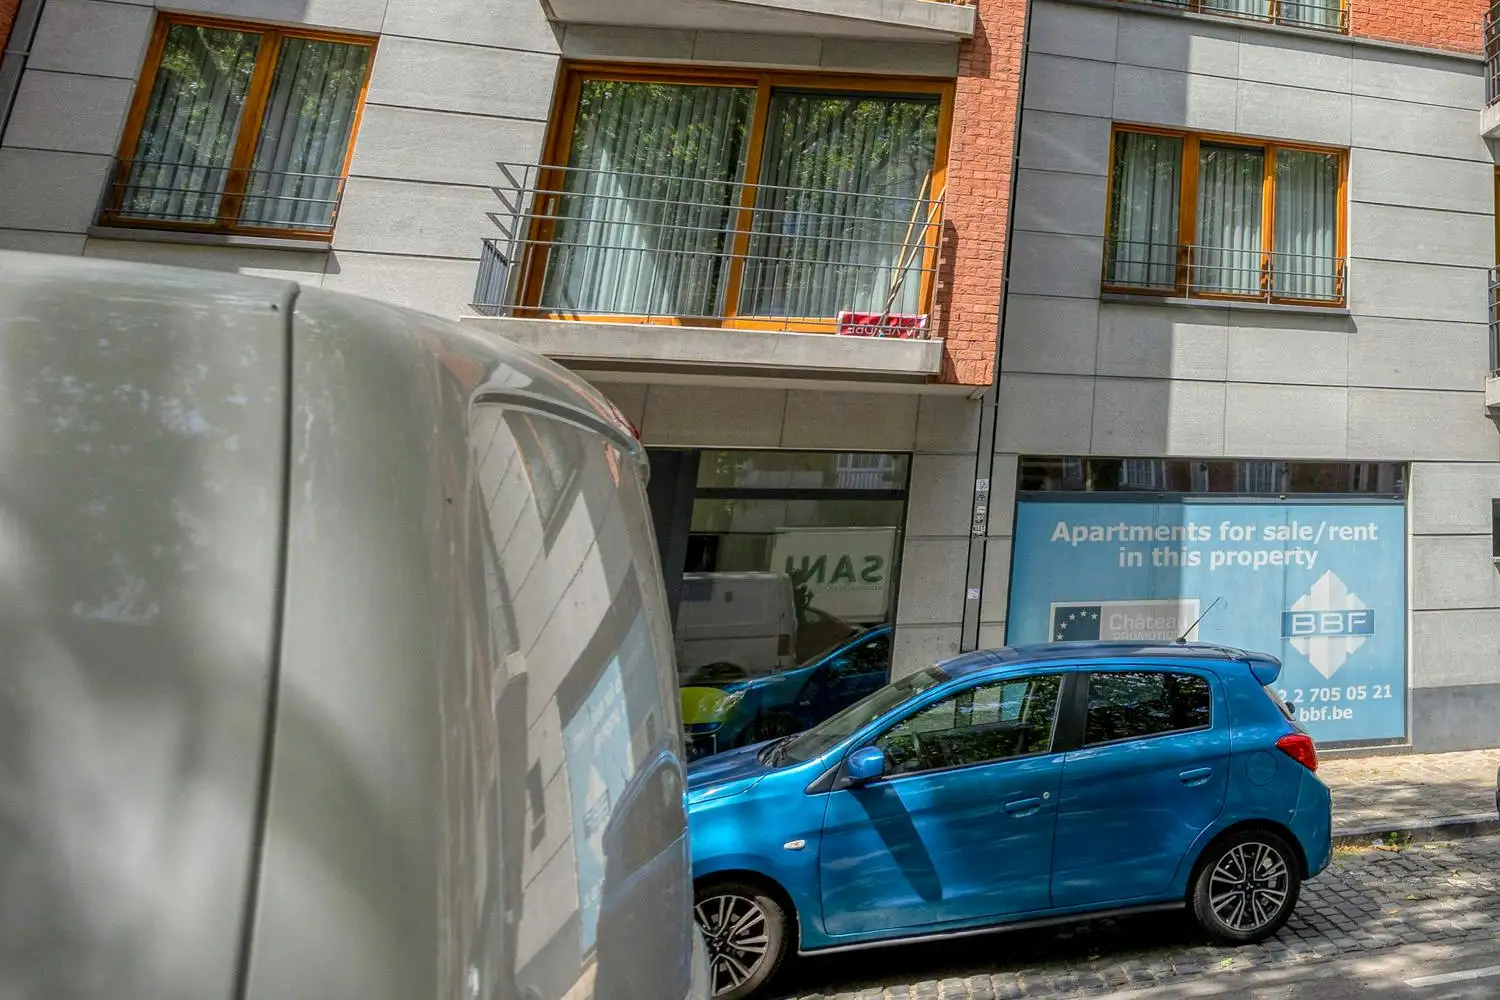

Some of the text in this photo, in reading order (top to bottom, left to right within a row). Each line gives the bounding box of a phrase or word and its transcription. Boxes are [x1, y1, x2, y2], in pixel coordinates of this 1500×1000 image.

[1051, 520, 1379, 547] Apartments for sale/rent
[1118, 546, 1319, 571] in this property
[1291, 611, 1367, 635] BBF
[1293, 689, 1304, 703] 2
[1309, 687, 1341, 702] 705
[1346, 685, 1367, 701] 05
[1372, 684, 1393, 699] 21
[1299, 706, 1353, 722] bbf.be
